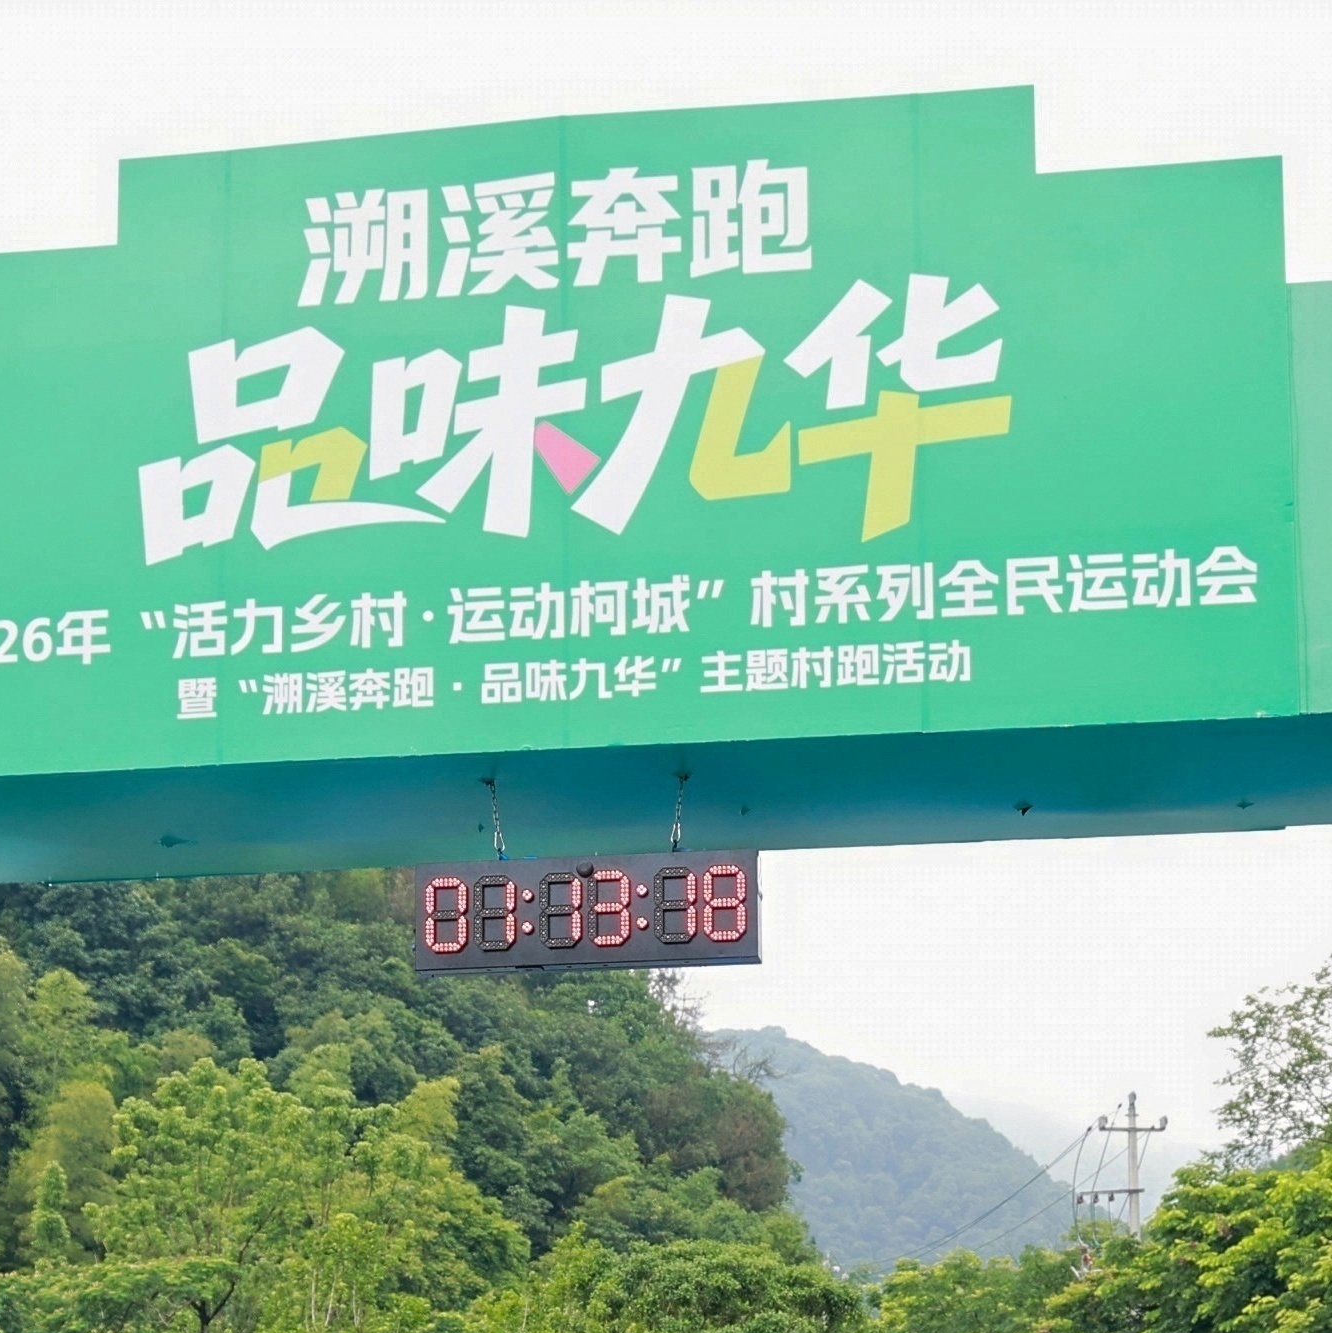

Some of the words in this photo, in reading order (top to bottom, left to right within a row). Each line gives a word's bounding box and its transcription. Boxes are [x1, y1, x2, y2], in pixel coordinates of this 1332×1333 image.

[296, 159, 812, 308] 溯溪奔跑
[138, 273, 1012, 567] 品味九华
[425, 864, 747, 953] 01:13:18
